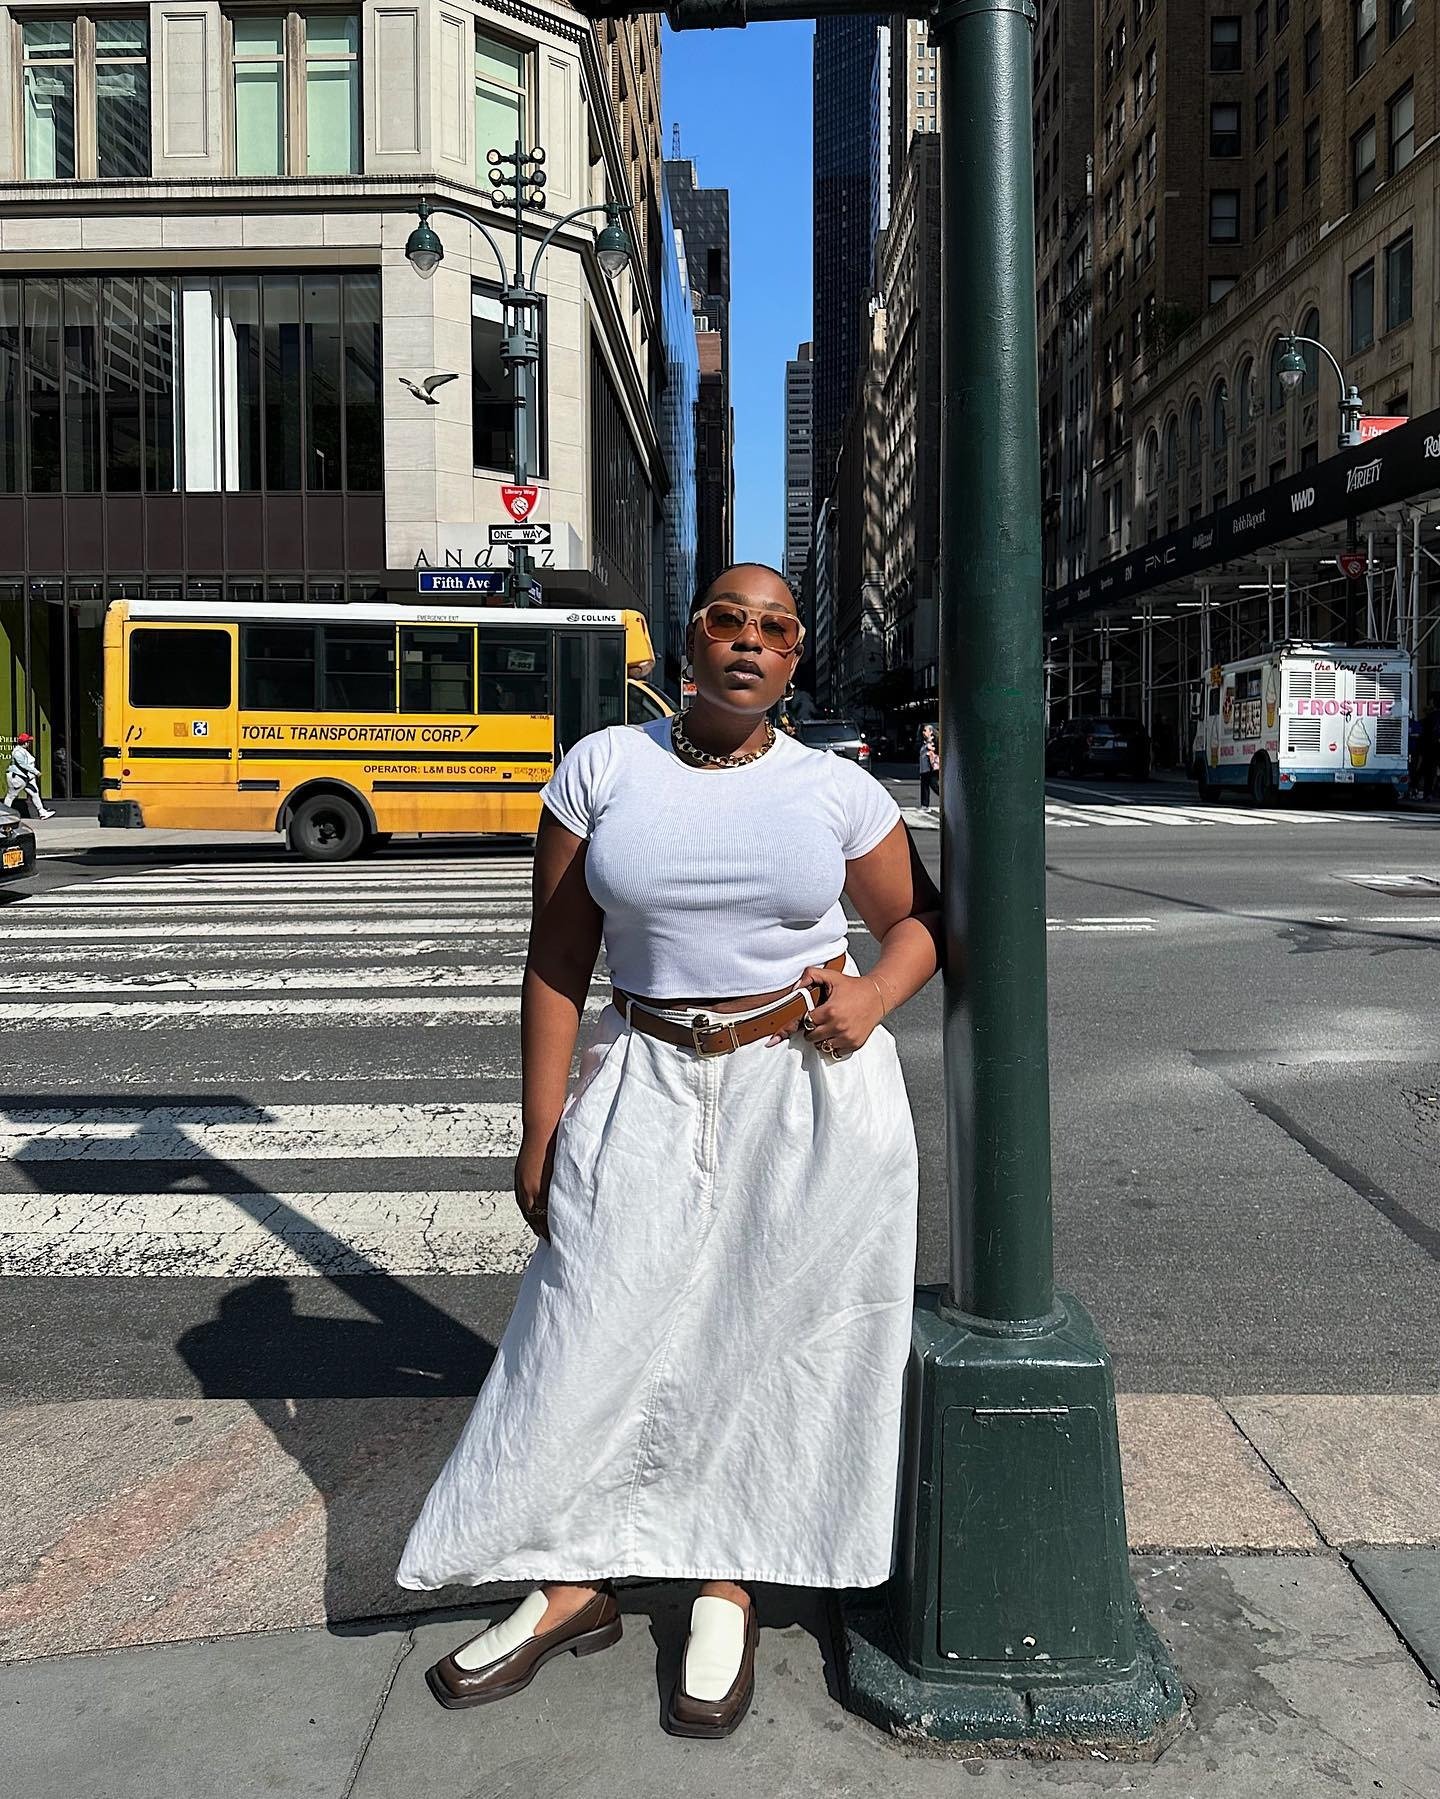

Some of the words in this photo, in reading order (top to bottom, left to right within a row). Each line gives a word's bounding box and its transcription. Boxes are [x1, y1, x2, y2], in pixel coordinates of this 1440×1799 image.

[1346, 460, 1383, 494] VARIETY
[1291, 487, 1315, 512] WWD
[494, 530, 512, 539] ONE
[522, 530, 543, 539] WAY
[415, 546, 555, 567] ANdZ
[432, 576, 463, 589] Fifth
[466, 577, 490, 589] Ave
[581, 614, 616, 622] COLLINS
[1334, 661, 1356, 674] Very
[1297, 698, 1394, 718] FROSTEE
[242, 726, 285, 740] TOTAL
[290, 726, 416, 743] TRANSPORTATION
[421, 728, 464, 742] CORP.
[363, 765, 421, 774] OPERATOR:
[423, 765, 444, 774] L&M
[446, 766, 466, 775] BUS
[468, 766, 497, 775] CORP.
